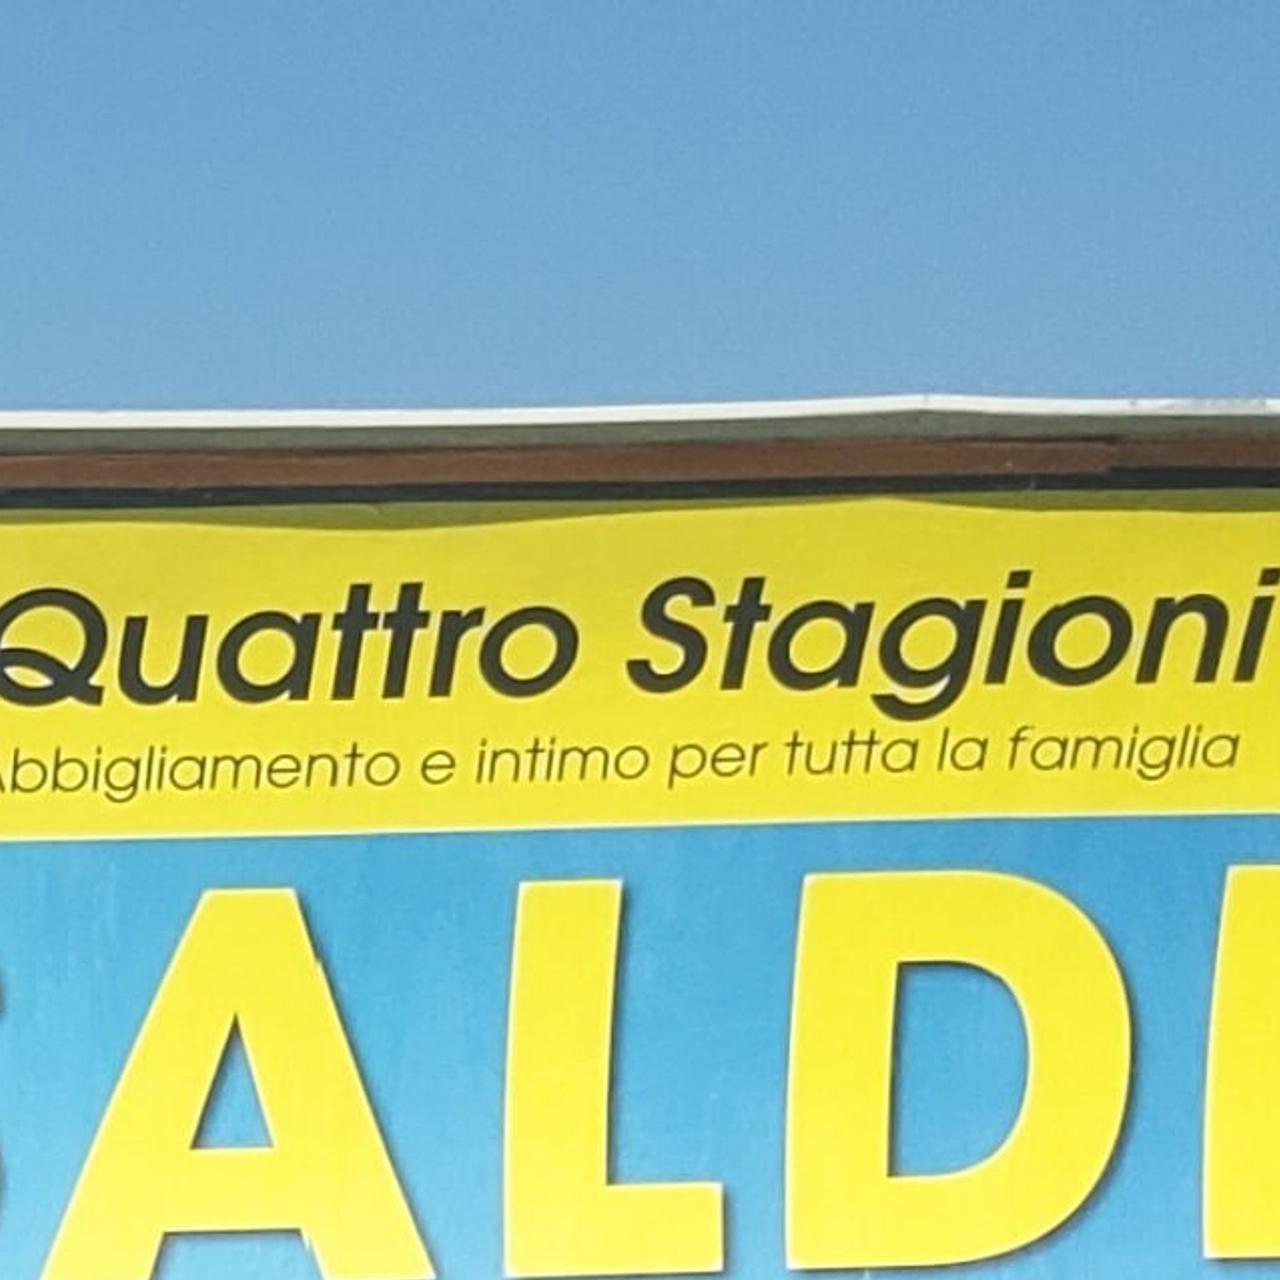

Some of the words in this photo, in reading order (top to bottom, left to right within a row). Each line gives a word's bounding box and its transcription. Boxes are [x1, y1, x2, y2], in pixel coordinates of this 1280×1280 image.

[420, 743, 456, 785] e
[475, 735, 650, 784] intimo
[668, 741, 769, 789] per
[785, 729, 920, 776] tutta
[937, 727, 989, 771] la
[1008, 723, 1240, 782] famiglia
